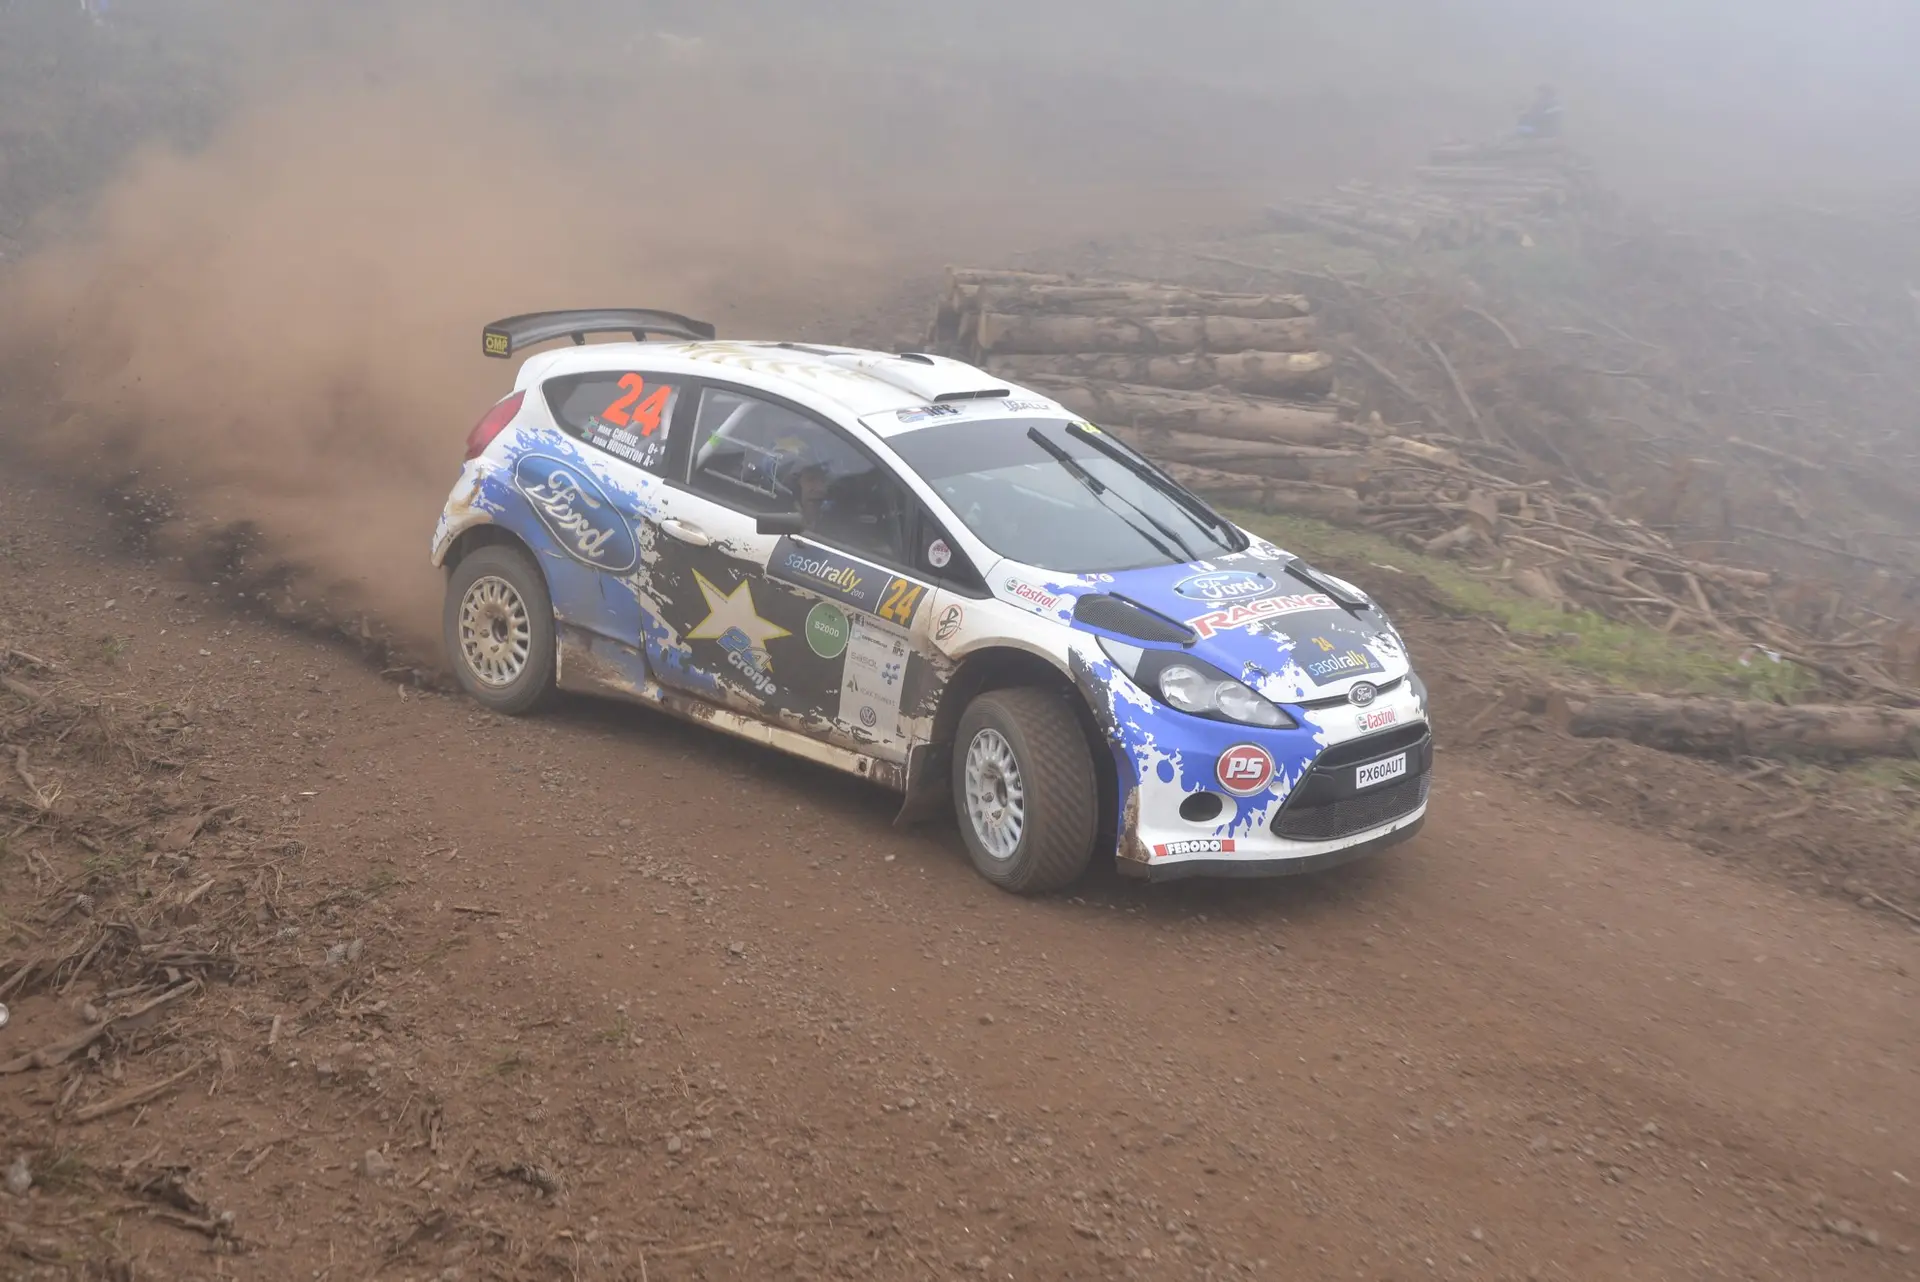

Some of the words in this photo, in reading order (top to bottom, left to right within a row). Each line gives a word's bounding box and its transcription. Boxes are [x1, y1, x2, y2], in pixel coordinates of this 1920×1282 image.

[486, 337, 508, 350] OMP
[602, 372, 672, 437] 24
[612, 427, 639, 448] CRONJE
[606, 439, 644, 464] HOUGHTON
[642, 455, 655, 467] A+
[525, 470, 615, 557] Ford
[785, 553, 862, 593] sasolrally
[850, 589, 865, 599] 2013
[1193, 574, 1265, 599] Ford
[879, 577, 922, 625] 24
[1016, 583, 1057, 608] Castrol
[1186, 594, 1339, 638] RACING
[814, 620, 840, 638] S2000
[1311, 636, 1335, 652] 24
[727, 650, 777, 695] Cronje
[1309, 649, 1370, 677] sasolrally
[1357, 687, 1373, 703] Ford
[1366, 707, 1396, 730] Castrol
[1225, 756, 1265, 780] PS
[1359, 757, 1404, 784] PX60AUT
[1166, 840, 1221, 854] FERODO
